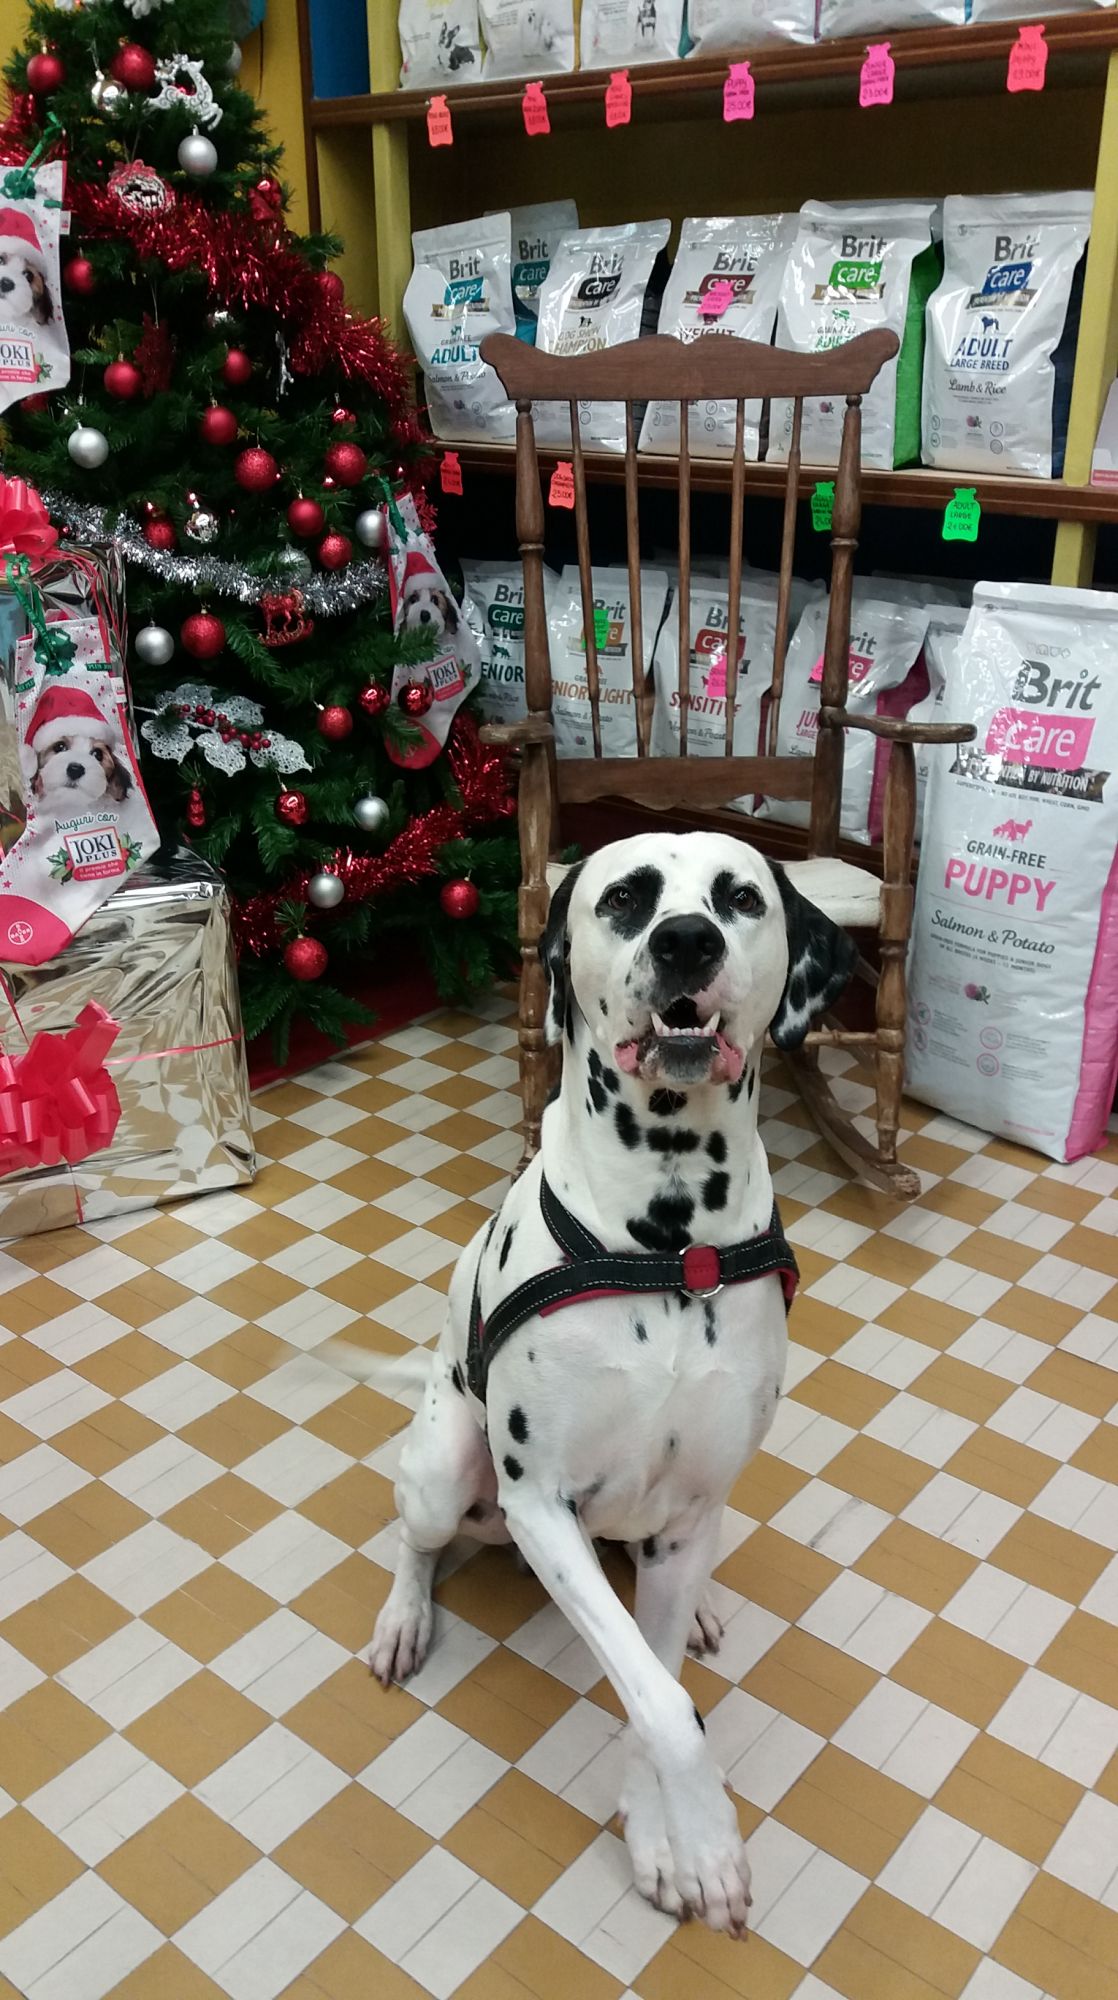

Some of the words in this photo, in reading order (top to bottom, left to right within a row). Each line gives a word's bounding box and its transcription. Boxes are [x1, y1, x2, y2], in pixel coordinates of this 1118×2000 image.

[519, 239, 548, 260] Brit
[841, 234, 887, 258] Brit
[994, 235, 1040, 261] Brit
[450, 256, 480, 280] Brit
[590, 253, 624, 275] Brit
[713, 252, 758, 271] Brit
[520, 266, 546, 281] care
[837, 266, 876, 283] care
[990, 269, 1026, 288] care
[451, 283, 478, 299] care
[585, 279, 615, 296] care
[0, 344, 29, 360] OKI
[431, 344, 479, 364] ADULT
[955, 337, 1014, 358] ADULT
[3, 359, 31, 367] PLUS
[950, 358, 978, 369] LARGE
[980, 359, 1010, 371] BREED
[948, 378, 975, 393] Lamb
[976, 384, 983, 393] &
[985, 381, 1007, 396] Rice
[954, 501, 976, 510] ADULT
[494, 584, 524, 605] Bri
[492, 608, 524, 625] care
[705, 606, 745, 633] Brt
[431, 661, 456, 688] JOKI
[481, 662, 524, 682] ENIOR
[552, 680, 588, 700] NIOR
[1012, 660, 1102, 711] Brit
[1005, 721, 1077, 757] care
[1027, 770, 1039, 783] BY
[1041, 772, 1089, 793] NUTRITION
[55, 814, 95, 834] Auguri
[98, 813, 118, 822] con
[72, 833, 116, 864] JOKI
[86, 850, 117, 863] PLUS
[966, 840, 1047, 869] GRAIN-FREE
[944, 858, 1057, 912] PUPPY
[931, 909, 984, 939] Salmon
[987, 930, 999, 943] &
[1001, 929, 1055, 954] Potato
